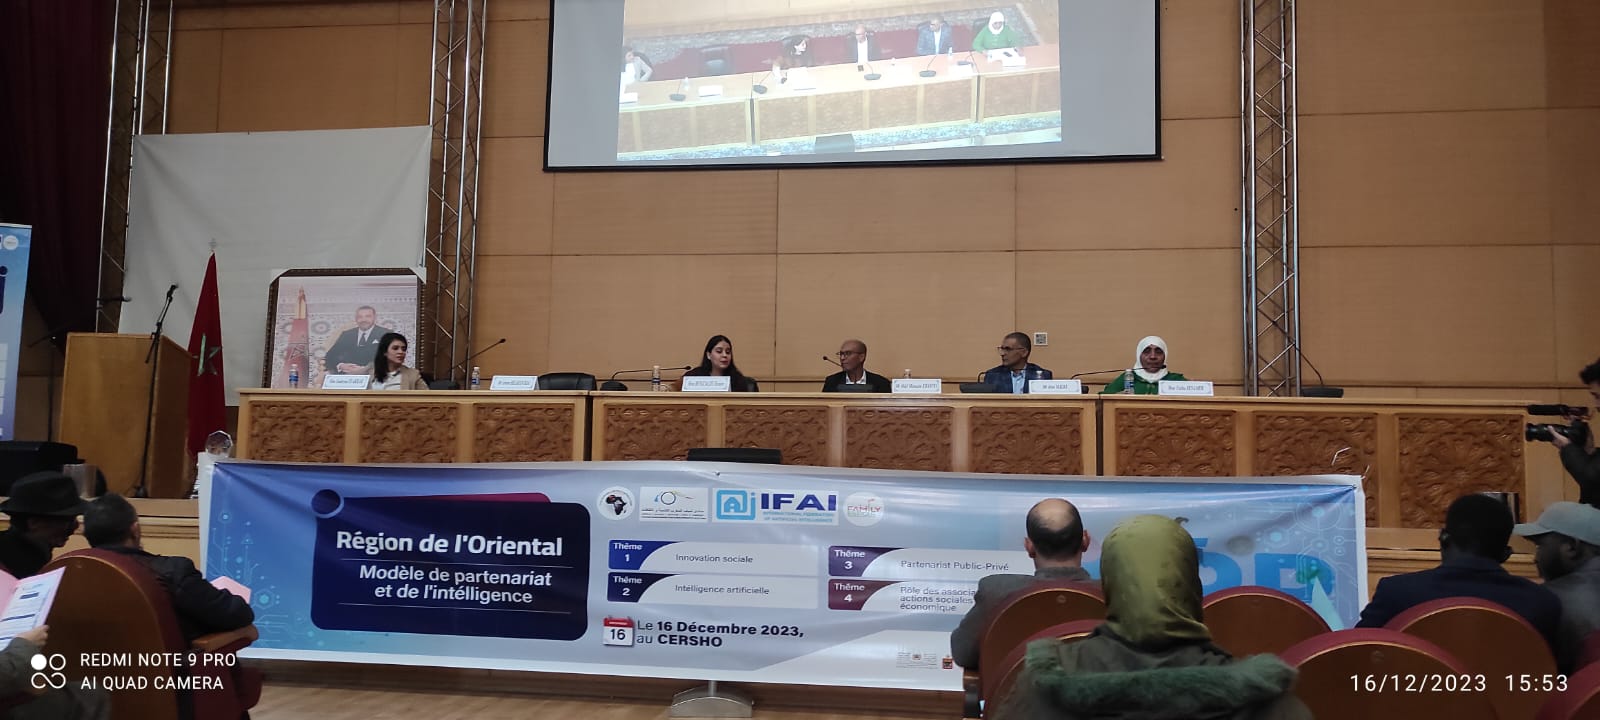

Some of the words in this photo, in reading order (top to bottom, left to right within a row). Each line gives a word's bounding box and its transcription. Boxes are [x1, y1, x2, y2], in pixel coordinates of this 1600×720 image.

[761, 493, 837, 511] IFAI
[336, 530, 413, 555] Région
[418, 533, 449, 553] de
[454, 534, 563, 557] l'Oriental
[613, 542, 643, 551] Thème
[624, 554, 631, 562] 1
[675, 553, 721, 563] Innovation
[722, 555, 753, 564] sociale
[834, 549, 865, 558] Thème
[844, 561, 853, 570] 3
[900, 560, 951, 570] Partenariat
[953, 562, 1009, 571] Public-Privé
[359, 564, 425, 581] Modèle
[428, 567, 450, 582] de
[454, 570, 553, 586] partenariat
[613, 575, 643, 584] Thème
[726, 586, 770, 595] artificielle
[834, 582, 865, 591] Thème
[900, 586, 921, 594] Rôle
[941, 588, 976, 596] associa
[374, 584, 392, 598] et
[396, 584, 419, 599] de
[423, 584, 533, 605] l'intélligence
[622, 588, 631, 596] 2
[843, 594, 853, 603] 4
[900, 595, 933, 603] actions
[935, 596, 974, 604] sociales
[900, 603, 957, 613] économique
[637, 620, 653, 631] Le
[657, 621, 672, 632] 16
[677, 621, 757, 635] Décembre
[760, 625, 804, 638] 2023,
[610, 628, 626, 641] 16
[636, 635, 653, 644] au
[657, 634, 723, 647] CERSHO
